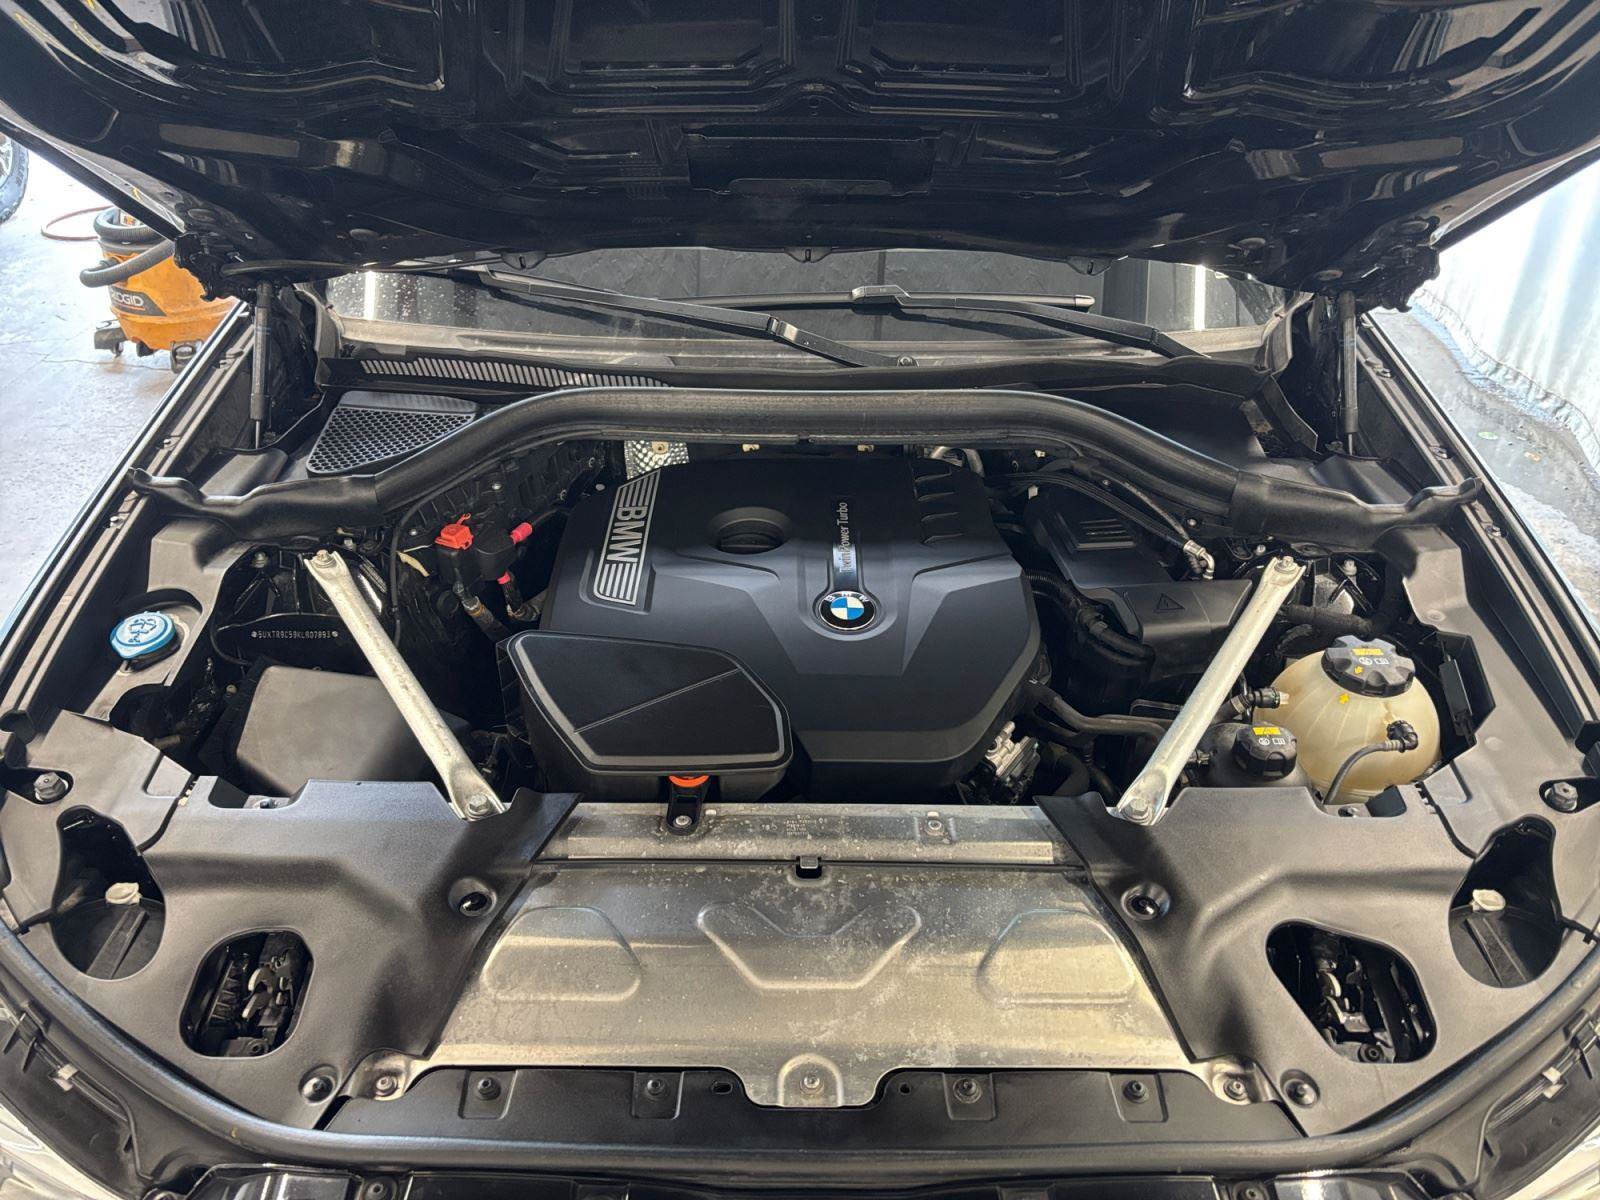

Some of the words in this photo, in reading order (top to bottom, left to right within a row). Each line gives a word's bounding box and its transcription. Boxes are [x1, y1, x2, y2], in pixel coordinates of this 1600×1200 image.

[836, 502, 849, 526] Turbo
[606, 506, 649, 563] BMW
[839, 526, 852, 573] TwinPower
[824, 591, 869, 602] BMW
